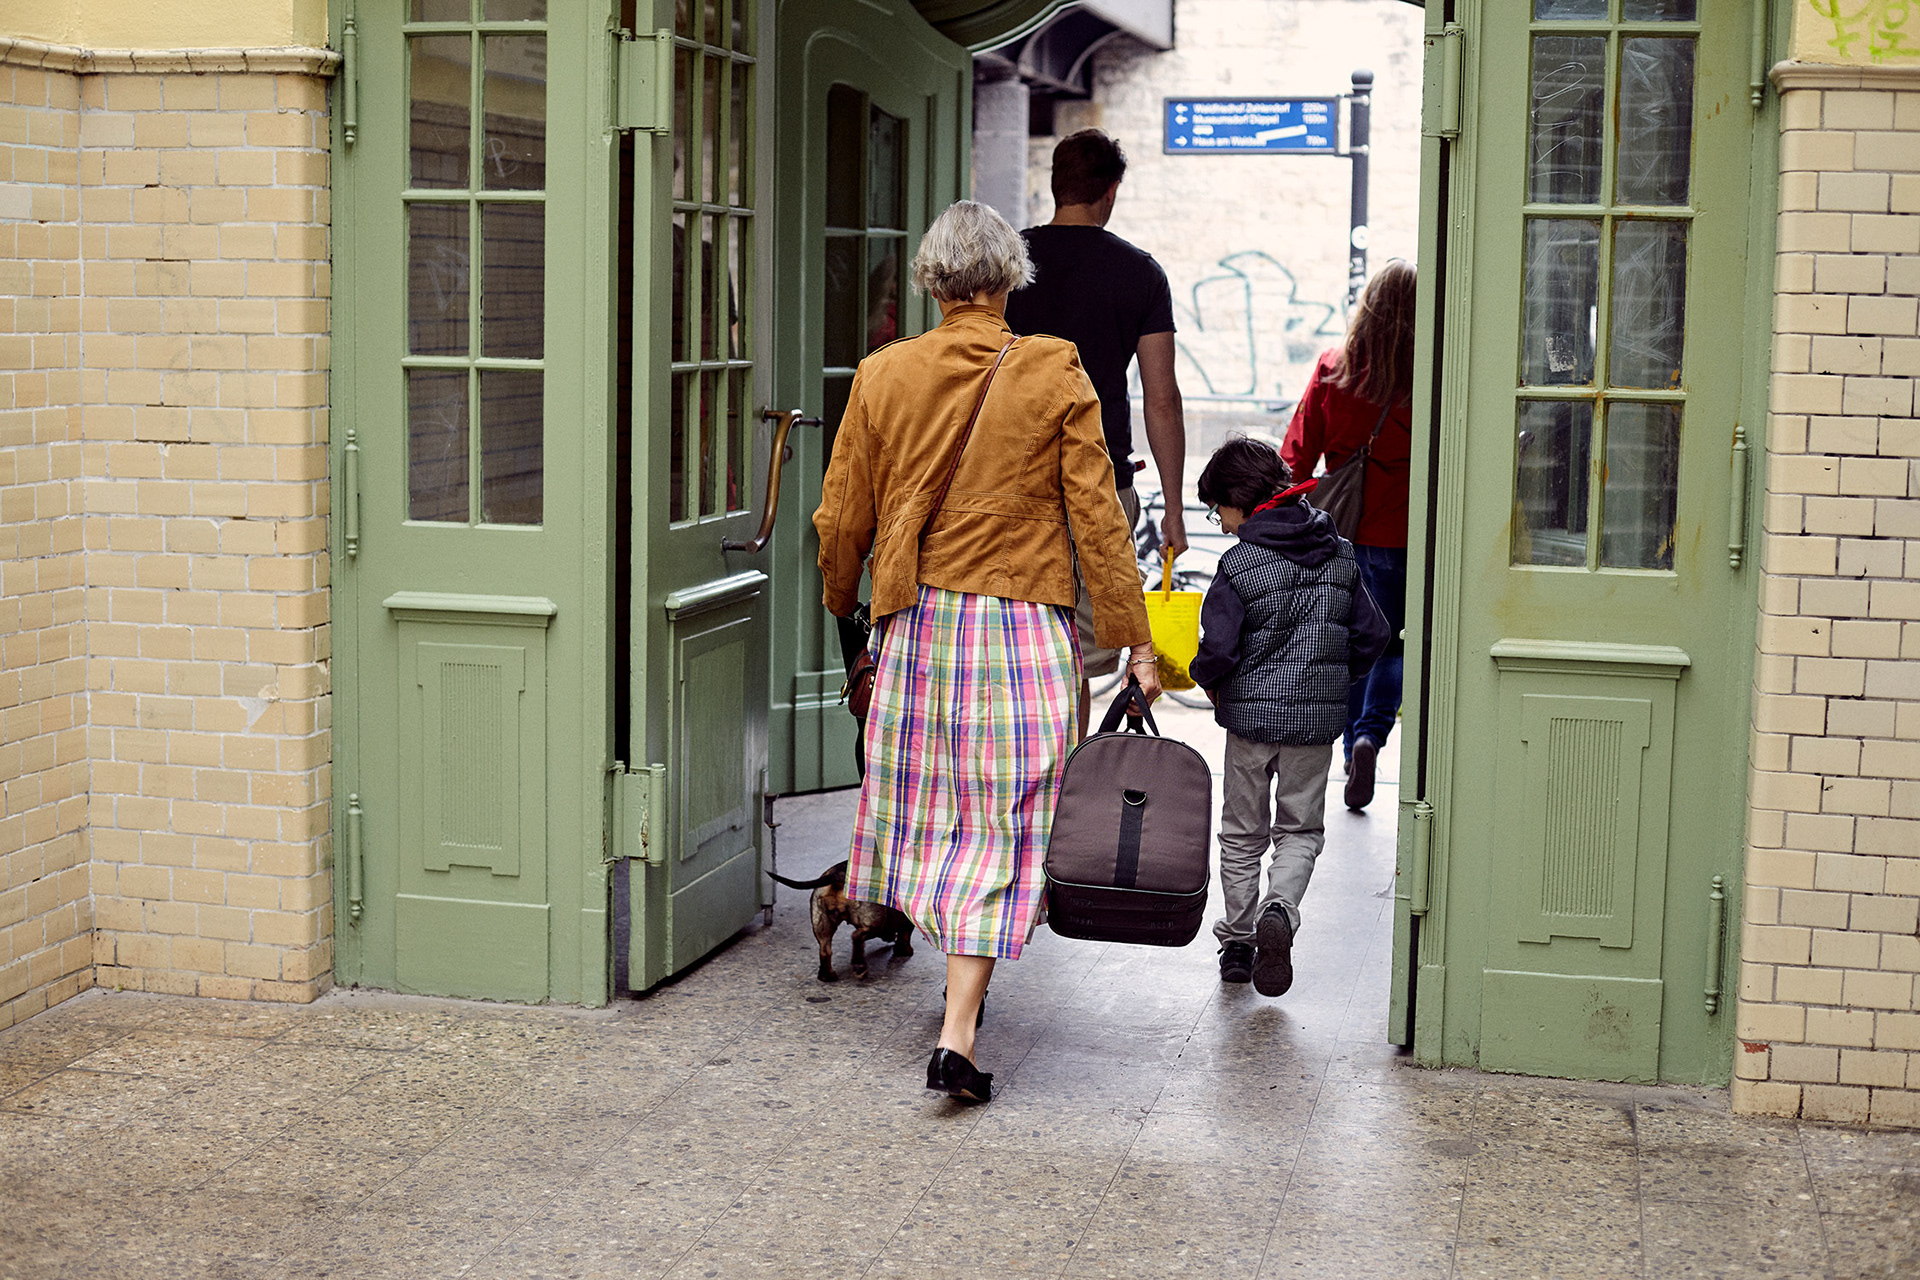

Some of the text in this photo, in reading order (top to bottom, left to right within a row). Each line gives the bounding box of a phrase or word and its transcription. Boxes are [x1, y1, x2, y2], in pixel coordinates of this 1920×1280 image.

[1246, 103, 1290, 113] Zehlendorf
[1193, 114, 1247, 125] Museumsdorf
[1192, 136, 1215, 146] Haus
